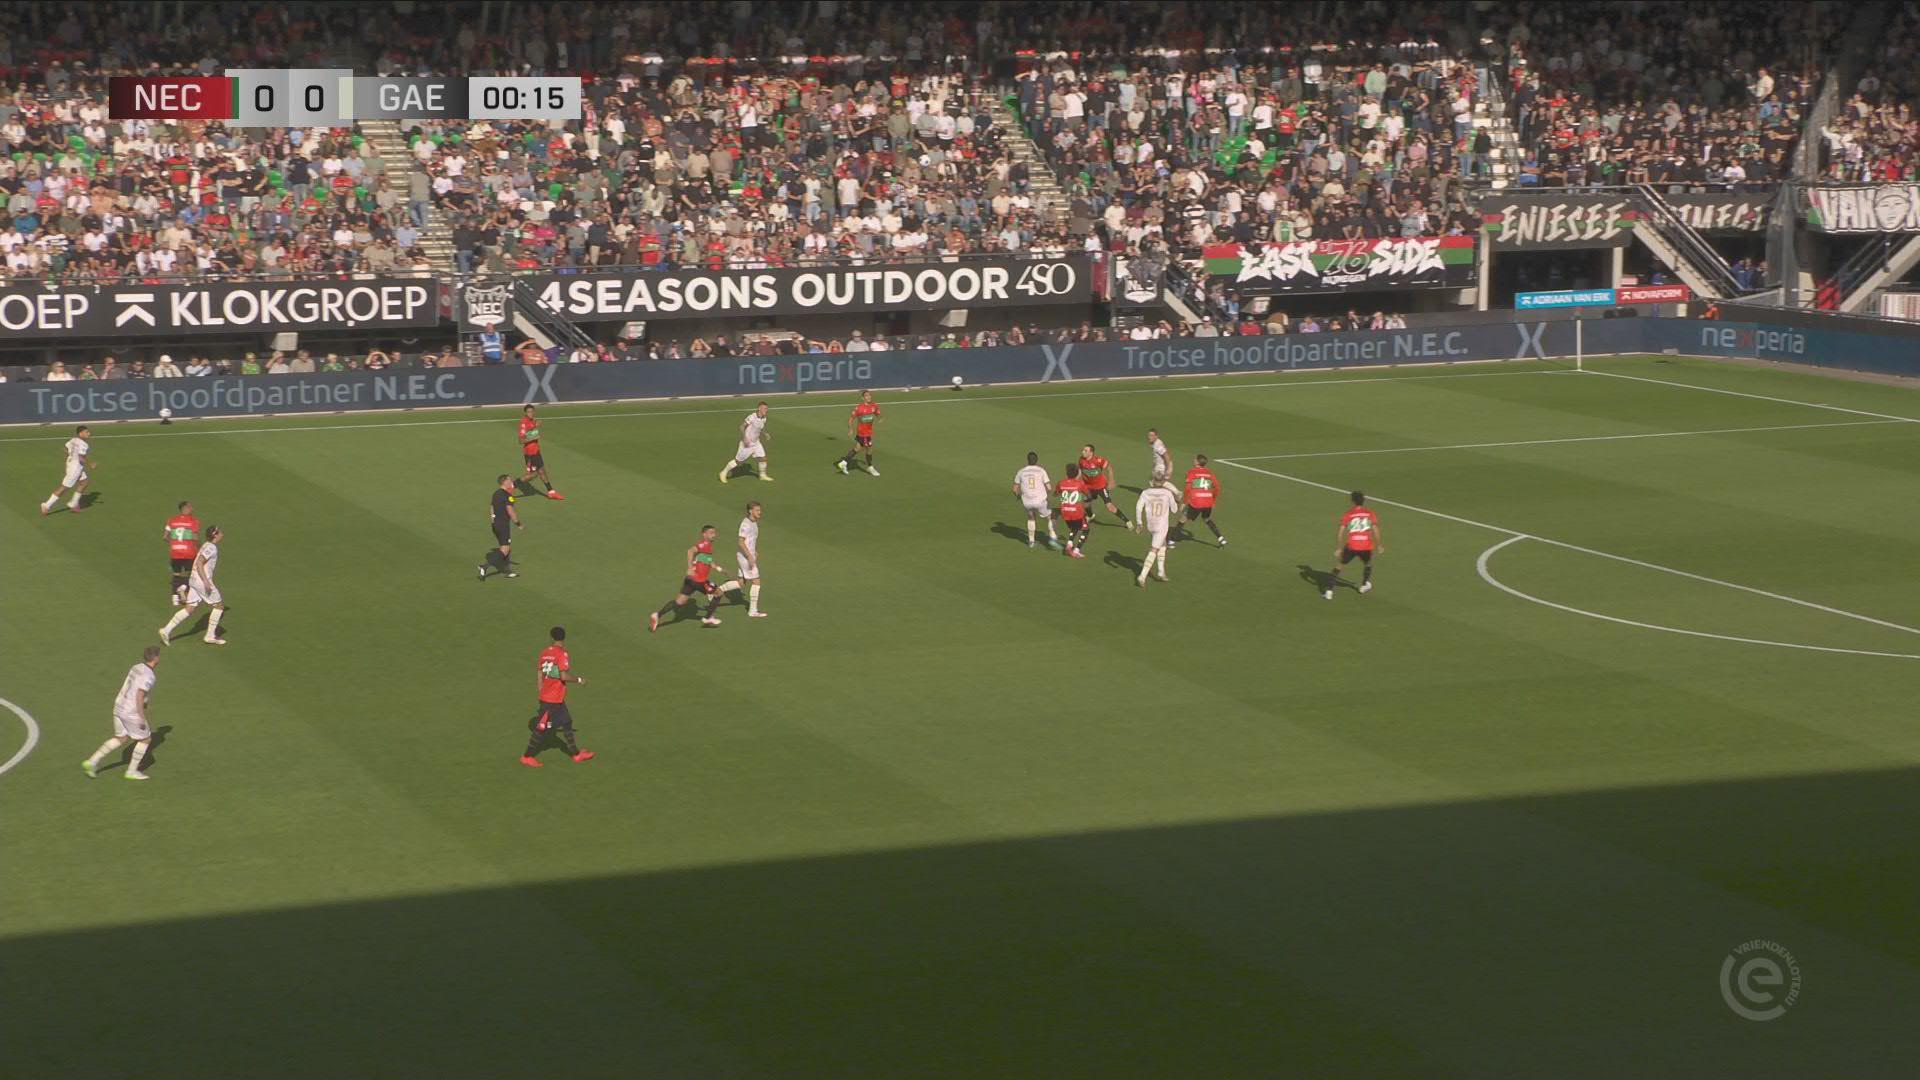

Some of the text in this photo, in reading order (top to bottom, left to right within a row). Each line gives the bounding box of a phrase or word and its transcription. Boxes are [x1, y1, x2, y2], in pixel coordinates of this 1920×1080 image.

[1236, 240, 1319, 283] EAST
[1369, 239, 1446, 280] SIDE
[170, 285, 428, 327] KLOKGROEP
[537, 275, 778, 314] 4SEASONS
[791, 267, 1009, 307] OUTDOOR
[1573, 292, 1593, 304] VAN
[1632, 288, 1682, 300] NOVAFORM
[0, 294, 89, 330] OEP
[470, 302, 502, 315] NEC
[1123, 331, 1469, 369] Trotse hoofdpartner N.E.C.
[1701, 327, 1805, 357] nexperia
[738, 354, 872, 391] nexperia
[29, 373, 465, 414] Trotse hoofdpartner N.E.C.
[1061, 490, 1079, 504] 30
[1199, 477, 1210, 490] 4
[175, 527, 185, 541] 9
